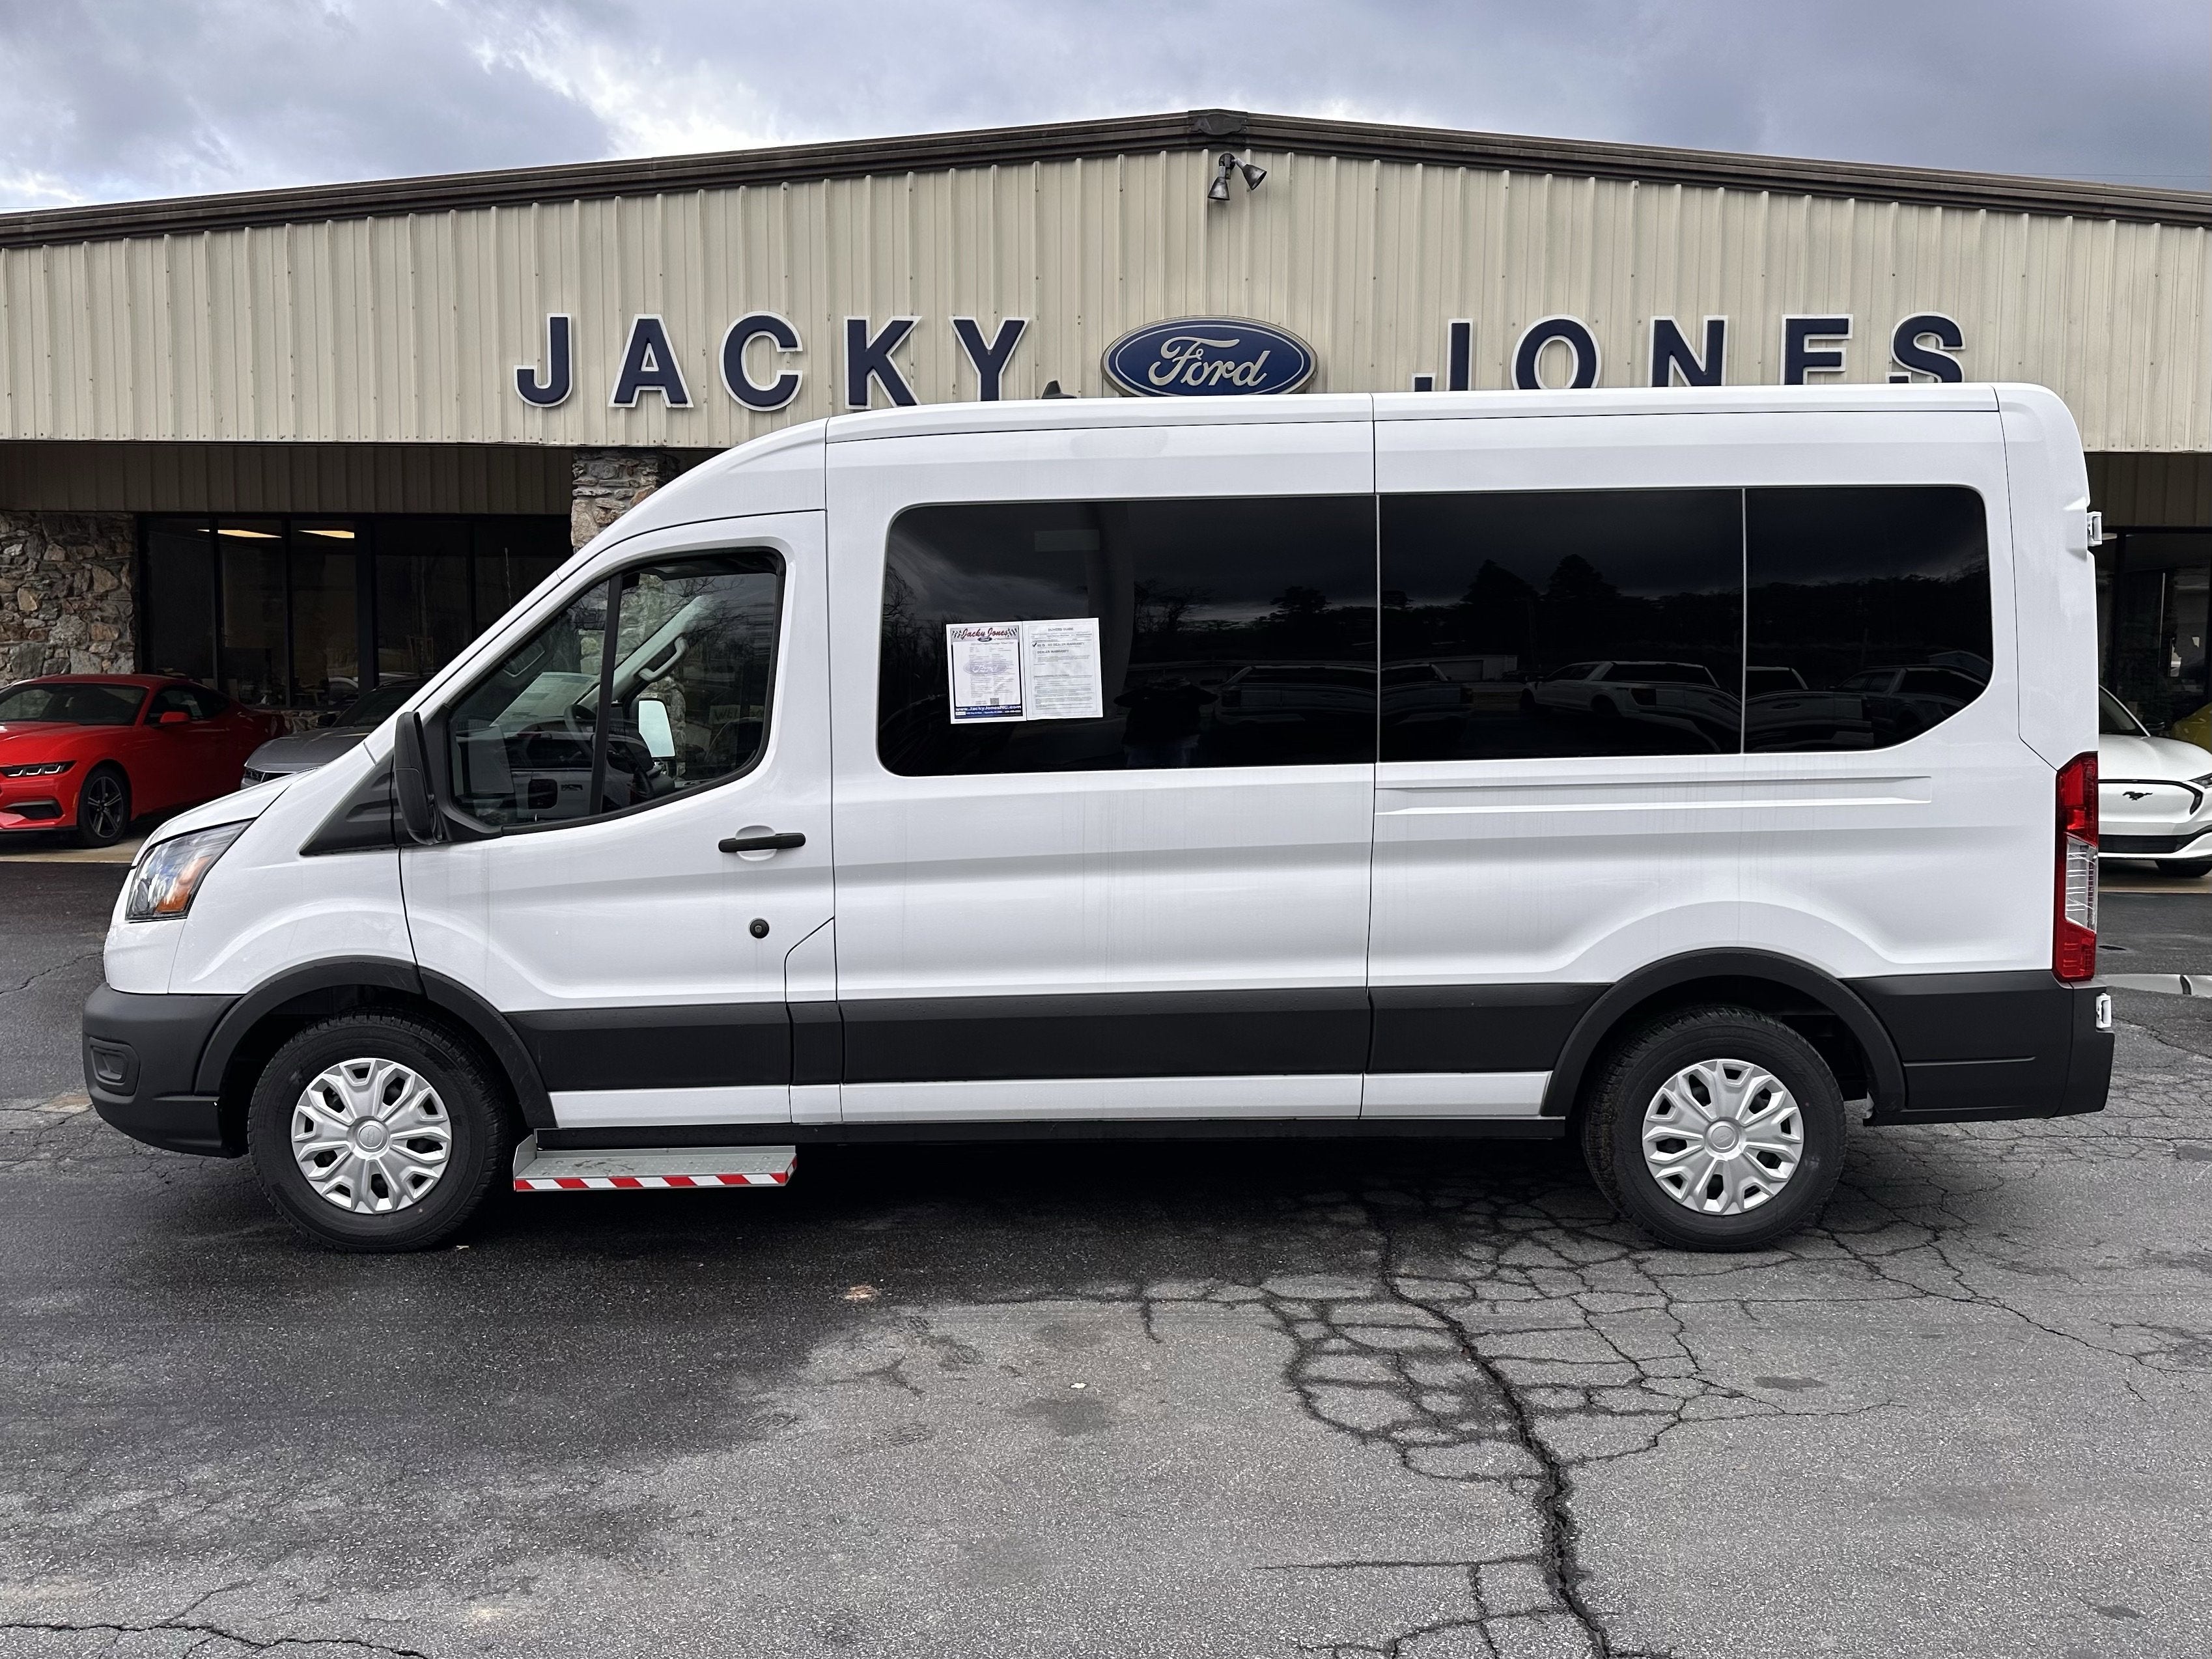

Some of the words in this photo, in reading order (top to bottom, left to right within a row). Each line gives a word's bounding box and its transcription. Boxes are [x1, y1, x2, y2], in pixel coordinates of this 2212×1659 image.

[514, 311, 1030, 411] JACKY
[1411, 311, 1967, 392] JONES
[1148, 336, 1271, 387] Ford
[960, 628, 985, 640] Jacky
[987, 627, 1008, 637] Jones
